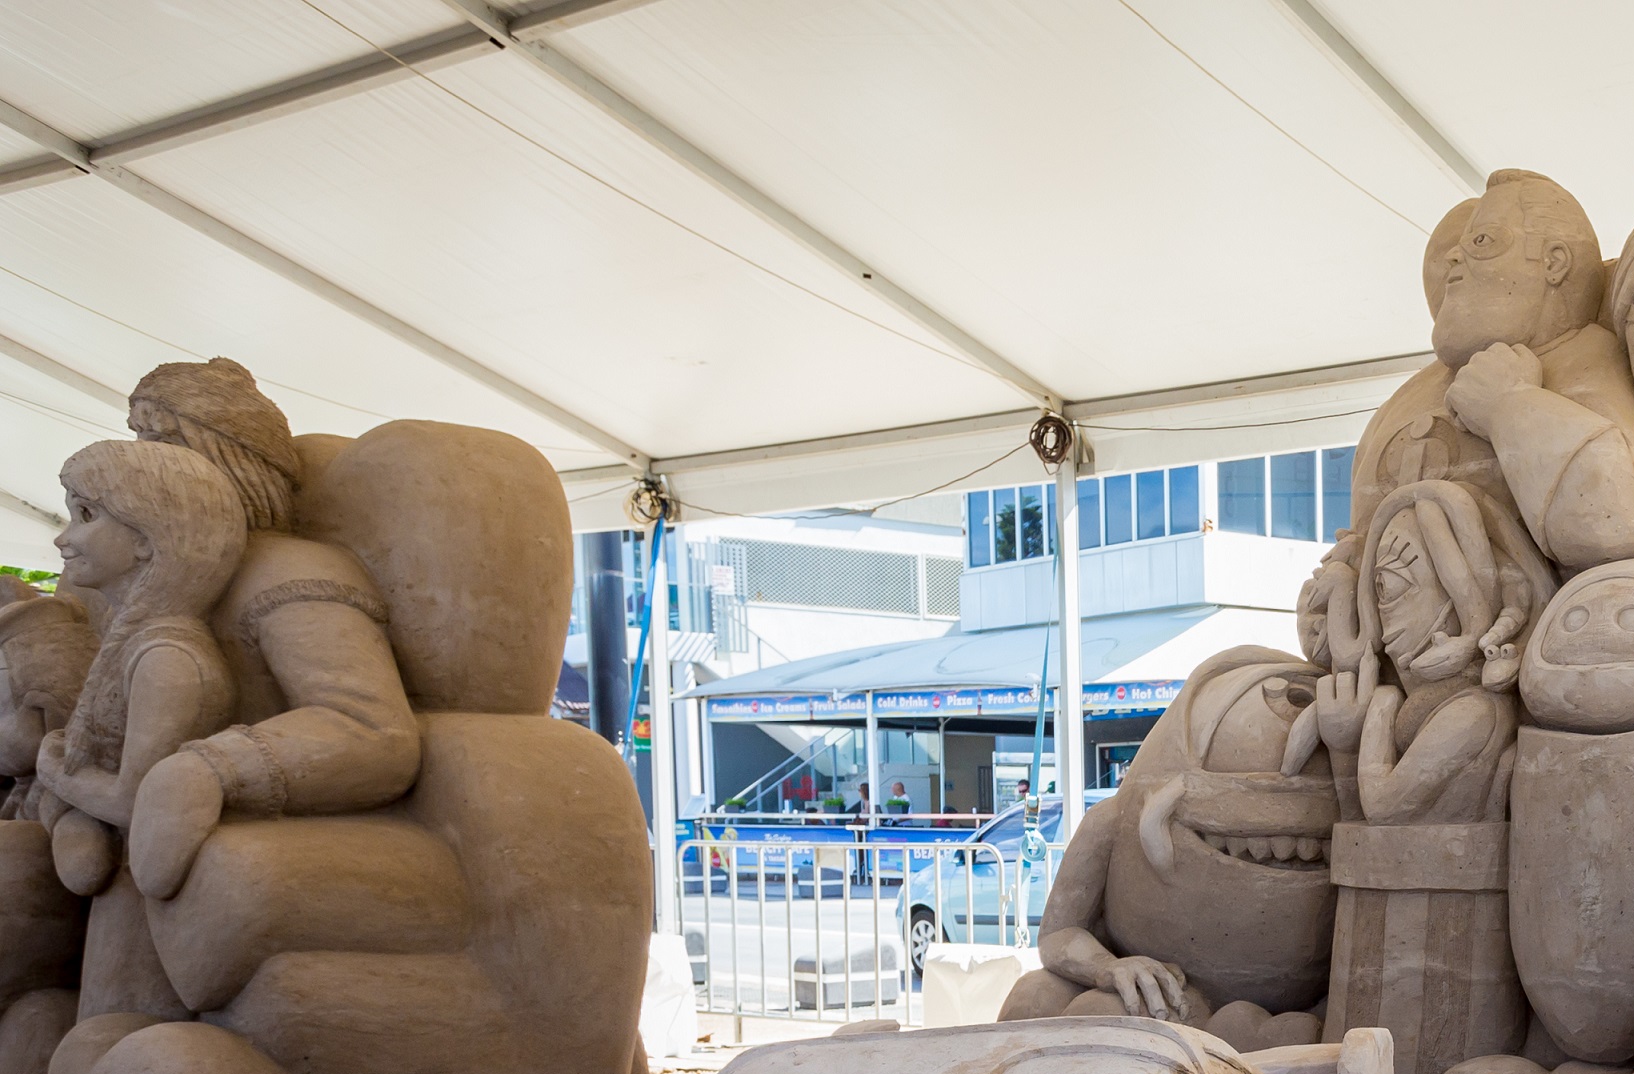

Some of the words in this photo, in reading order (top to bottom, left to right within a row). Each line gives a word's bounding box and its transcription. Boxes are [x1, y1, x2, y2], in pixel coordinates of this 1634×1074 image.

[988, 693, 1015, 705] Fresh
[1132, 688, 1152, 699] Hot
[814, 700, 834, 711] Fruit
[837, 699, 866, 710] Salads
[877, 696, 897, 709] Cold
[900, 697, 928, 708] Drinks
[947, 695, 973, 706] Pizza
[760, 703, 773, 713] Ice
[776, 702, 806, 713] Creams
